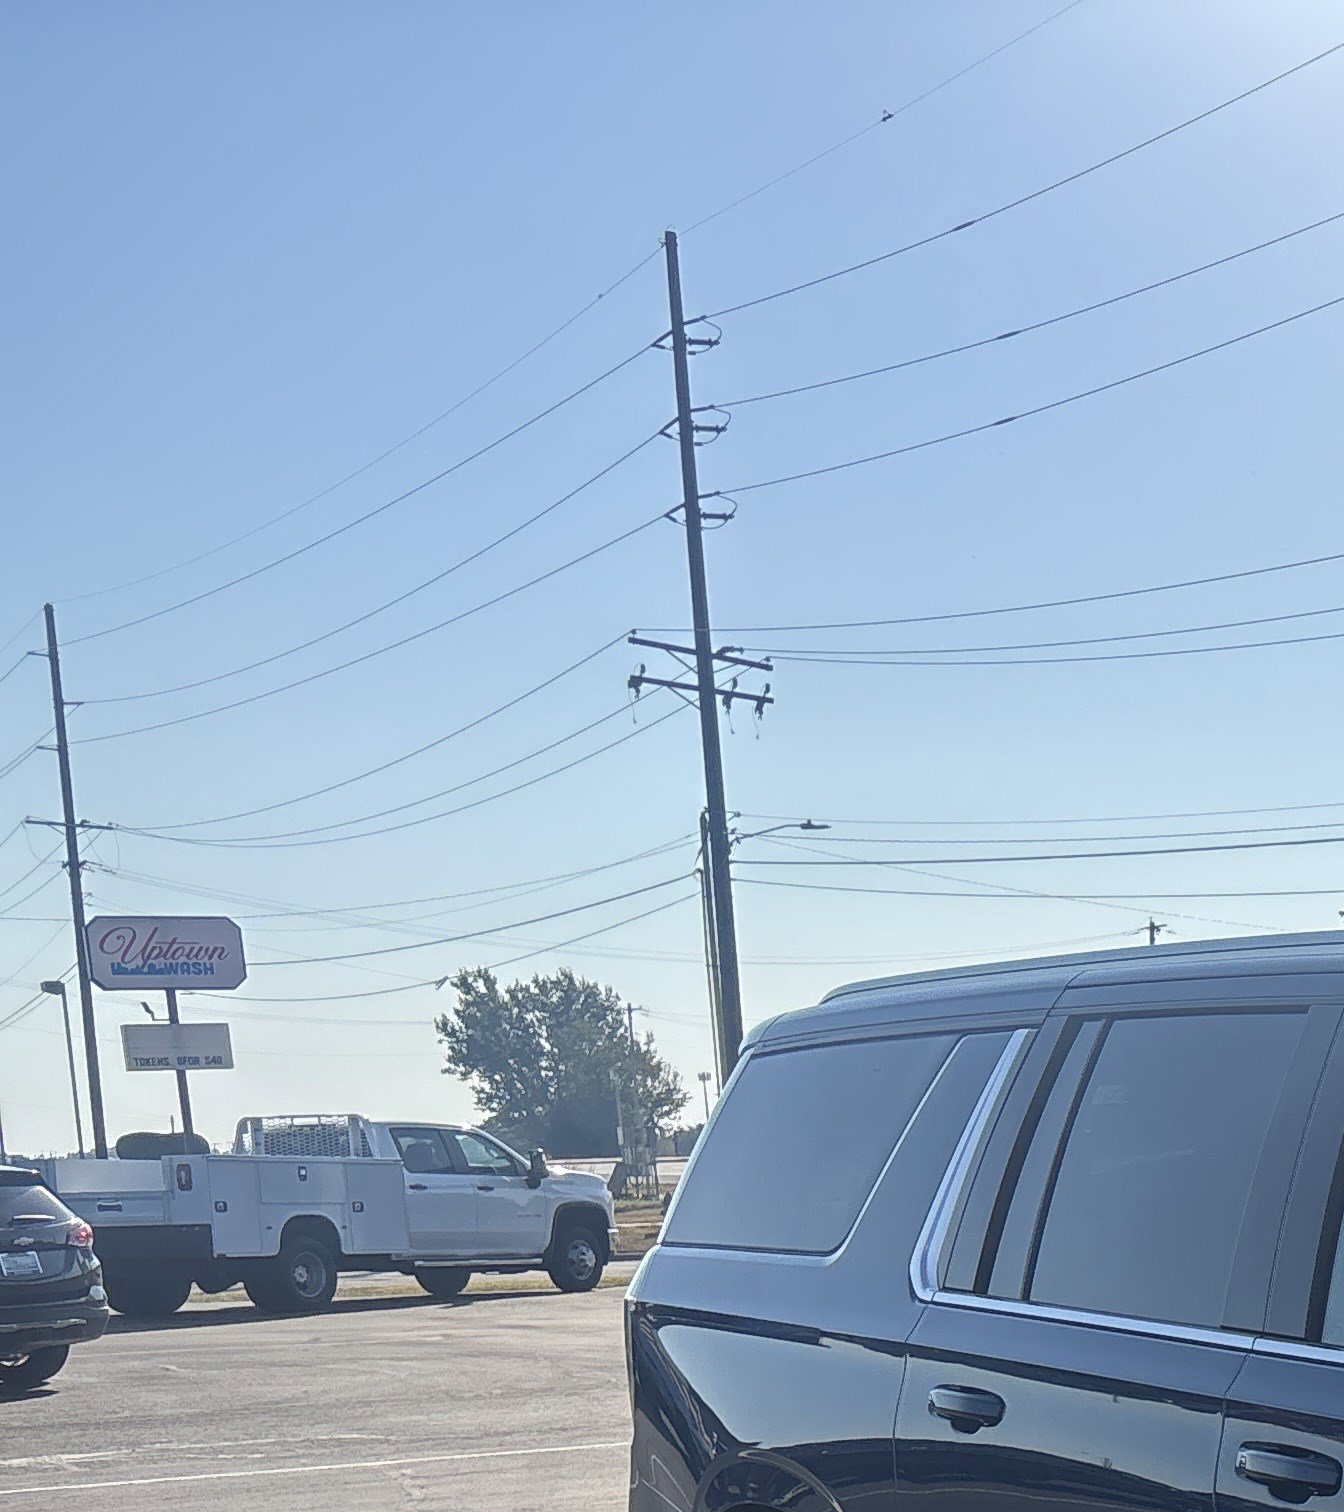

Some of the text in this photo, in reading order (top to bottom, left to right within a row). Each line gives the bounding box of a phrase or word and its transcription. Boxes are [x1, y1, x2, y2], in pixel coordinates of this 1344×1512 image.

[99, 926, 230, 970] Uptown
[167, 962, 215, 976] WASH
[132, 1056, 170, 1067] TOKENS
